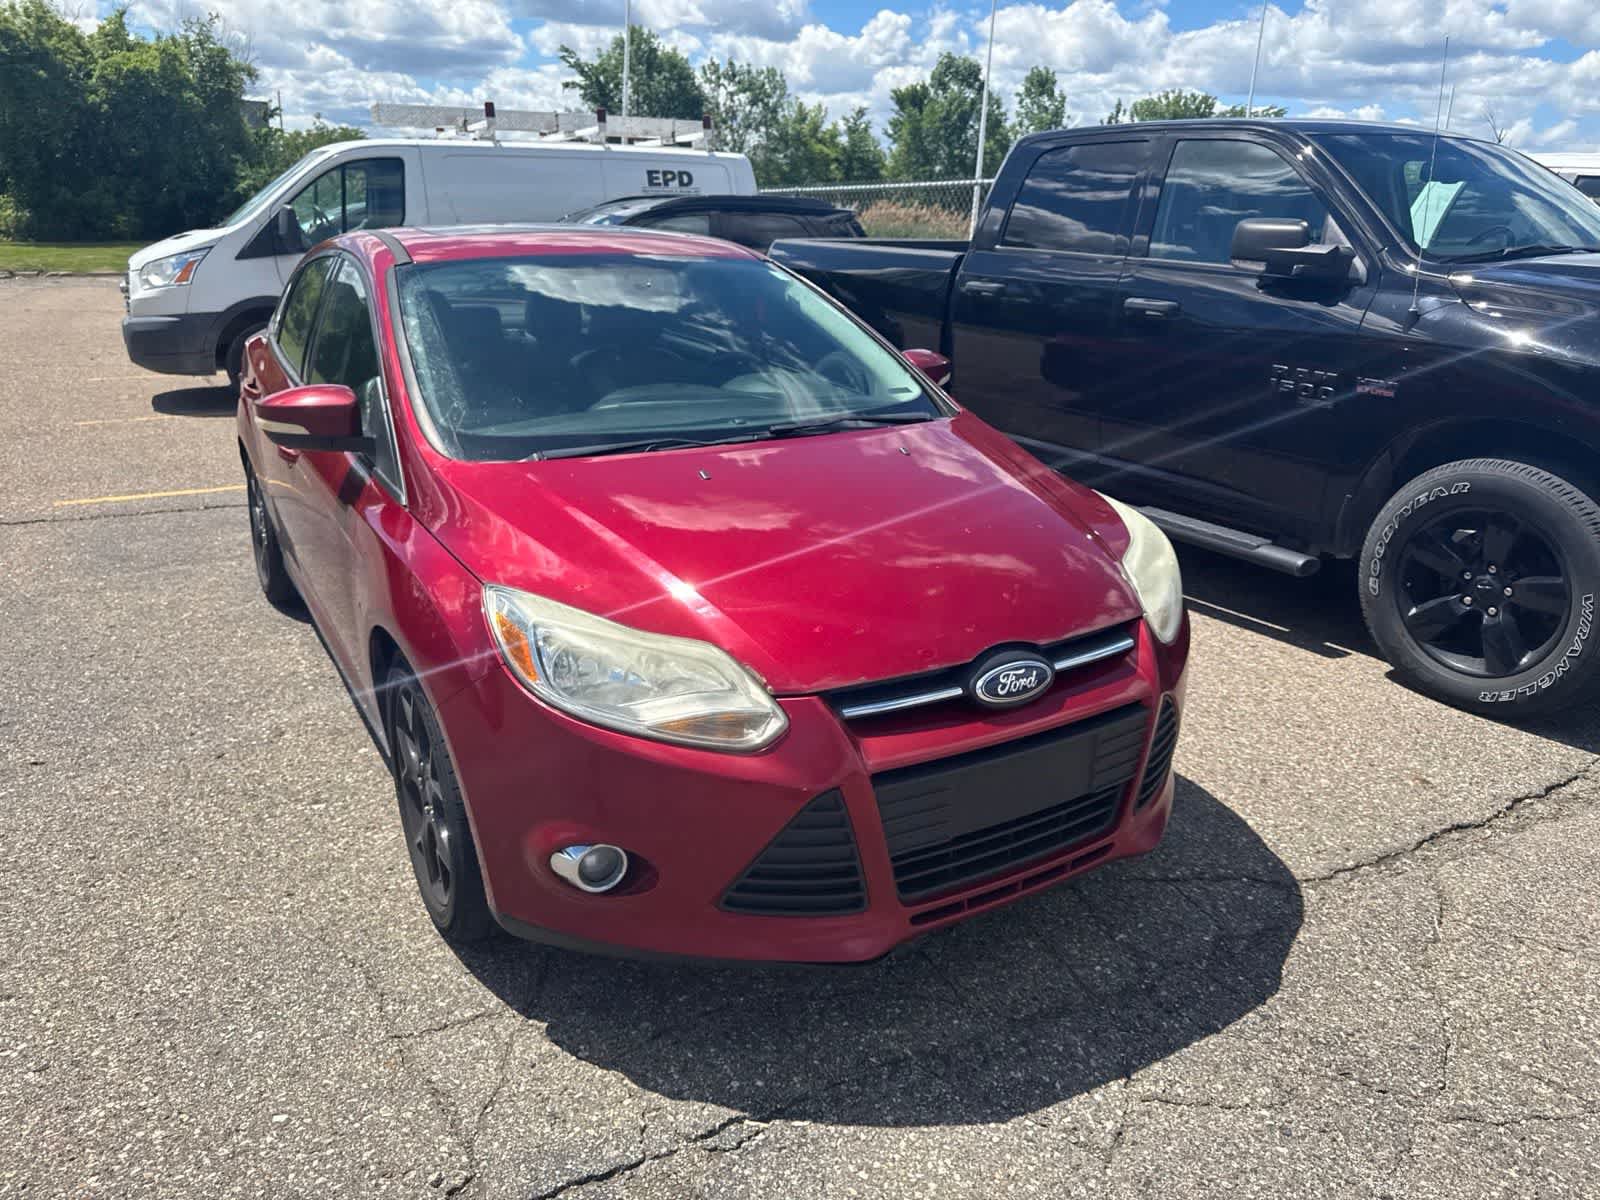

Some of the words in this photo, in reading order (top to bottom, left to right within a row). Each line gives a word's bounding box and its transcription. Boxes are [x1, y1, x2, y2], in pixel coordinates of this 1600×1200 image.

[646, 170, 693, 187] EPD
[1369, 482, 1471, 596] GOODYEAR
[1478, 593, 1593, 702] WRANGLER
[997, 668, 1038, 696] Ford
